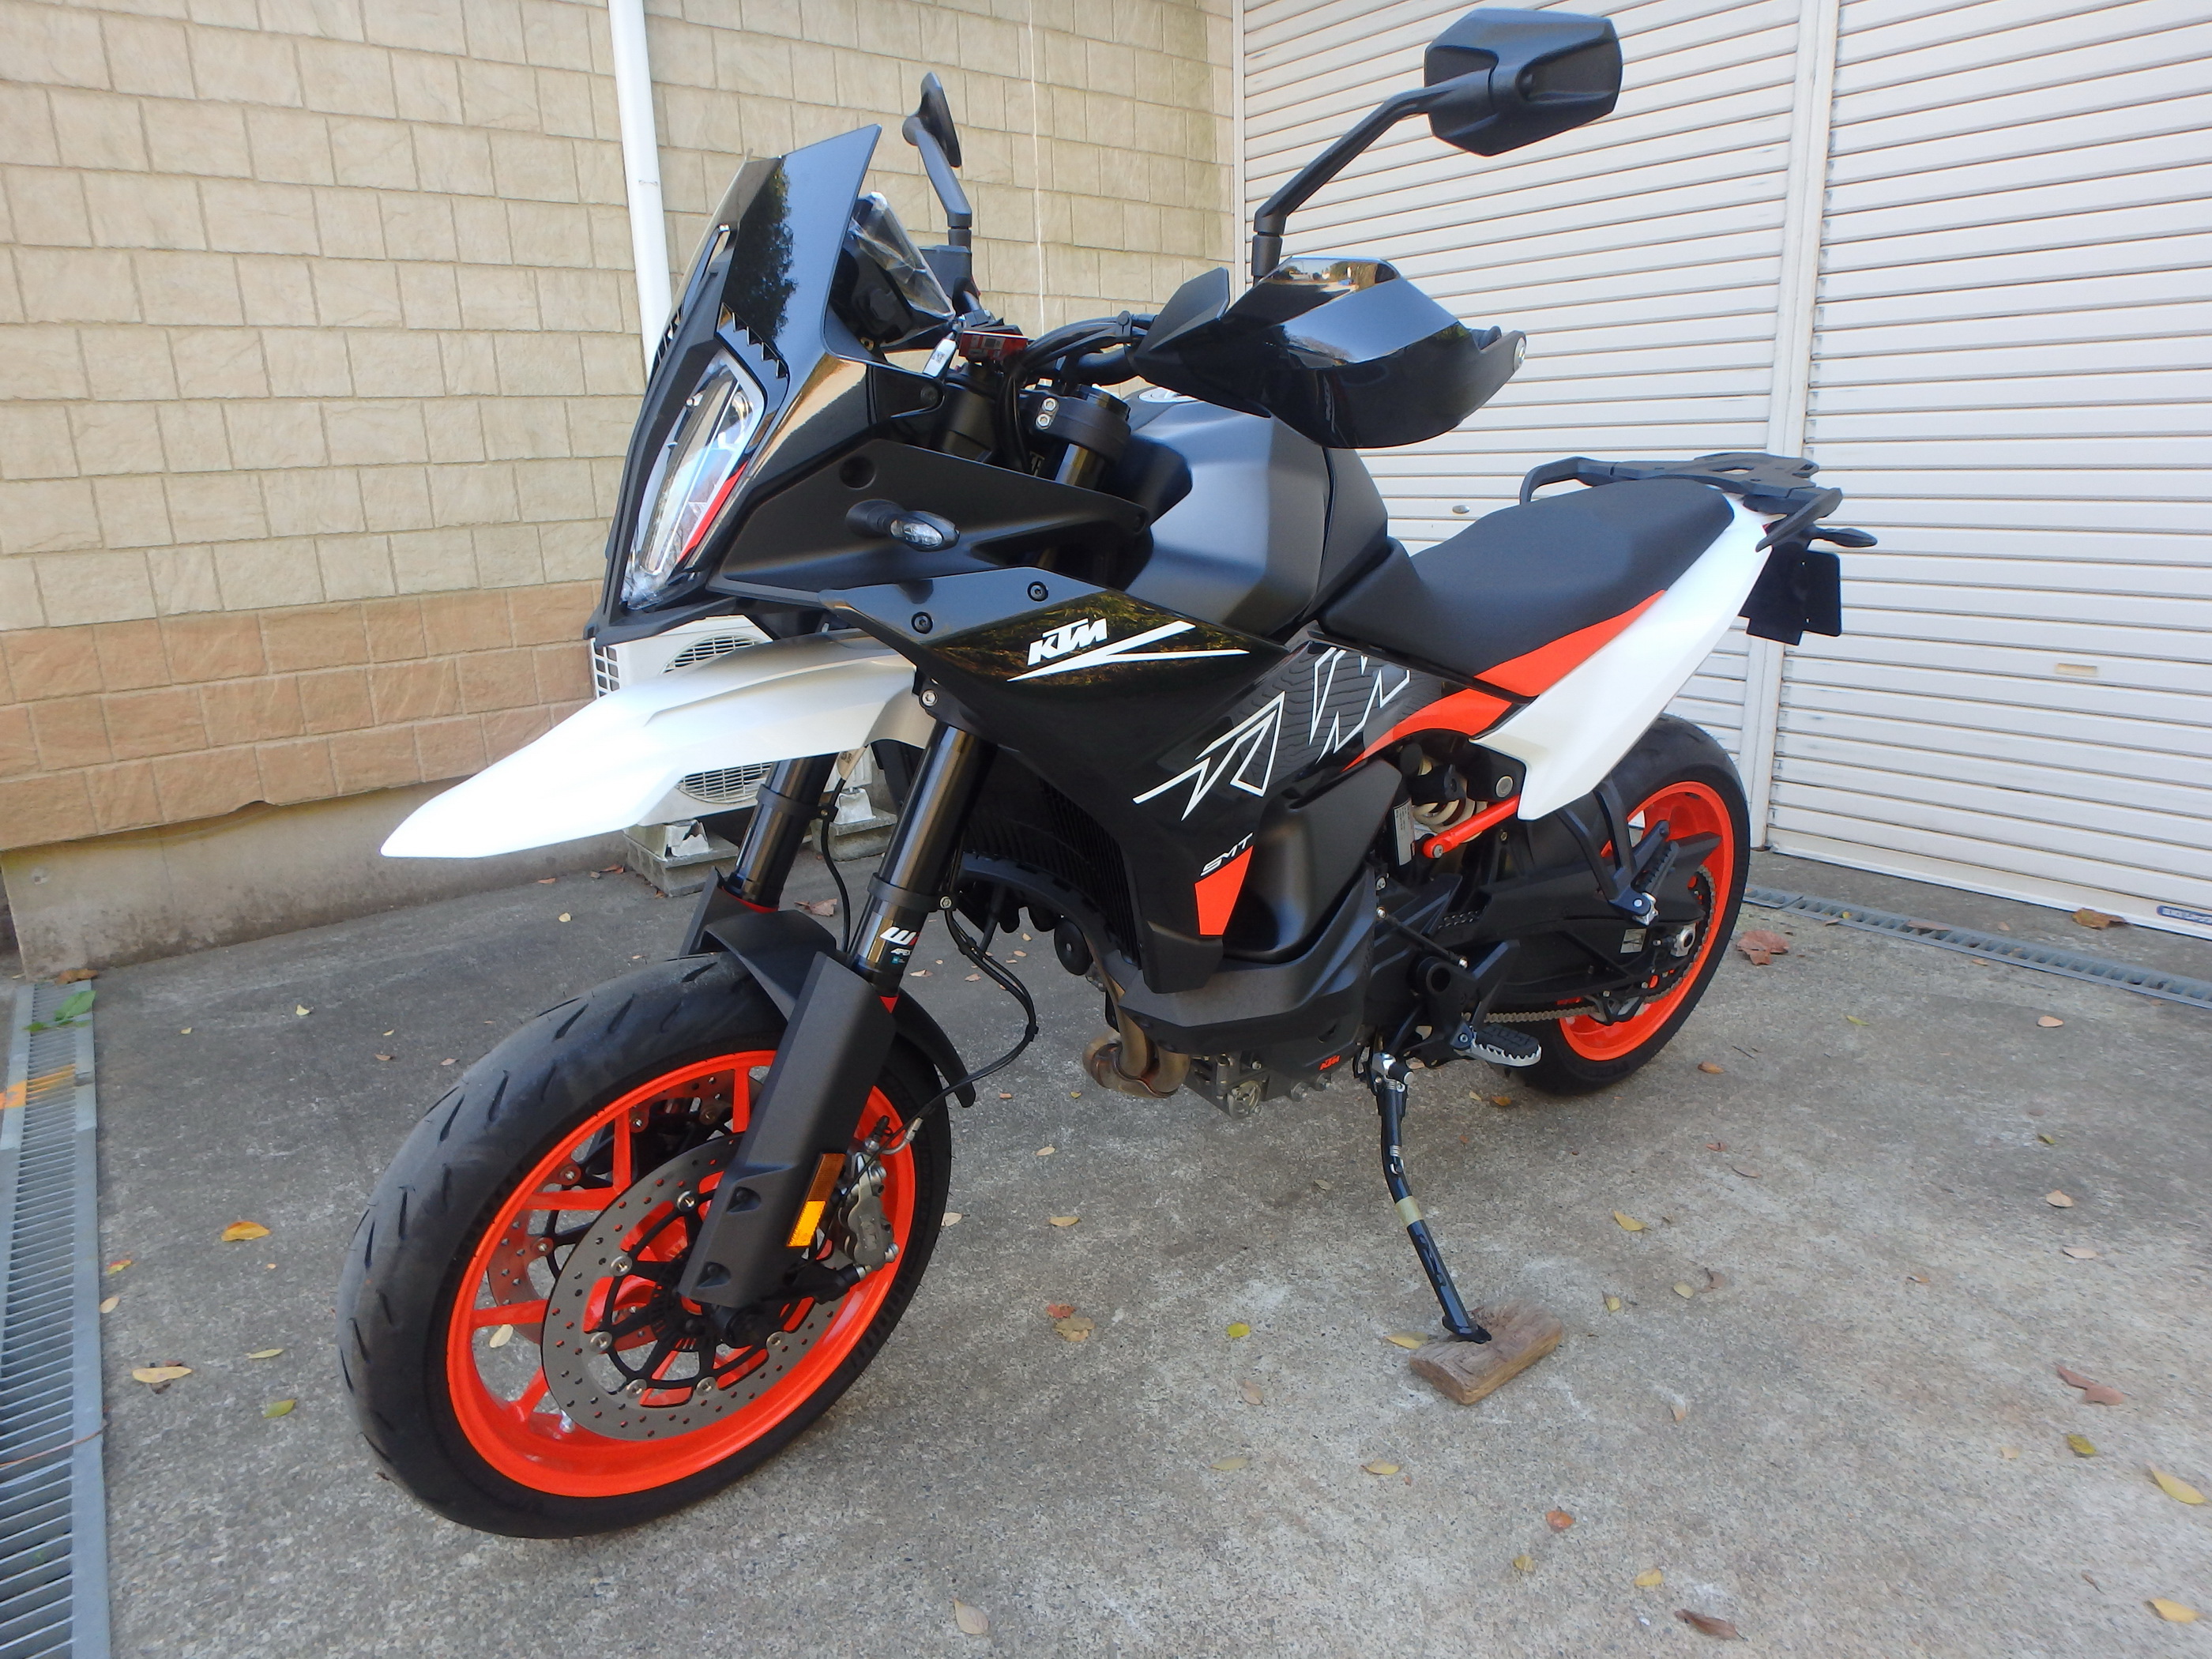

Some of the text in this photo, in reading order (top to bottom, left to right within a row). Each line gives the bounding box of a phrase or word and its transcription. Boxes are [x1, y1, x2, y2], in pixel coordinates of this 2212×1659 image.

[1027, 617, 1108, 666] KTM
[1200, 832, 1254, 877] SMT
[1319, 1055, 1341, 1070] KTM
